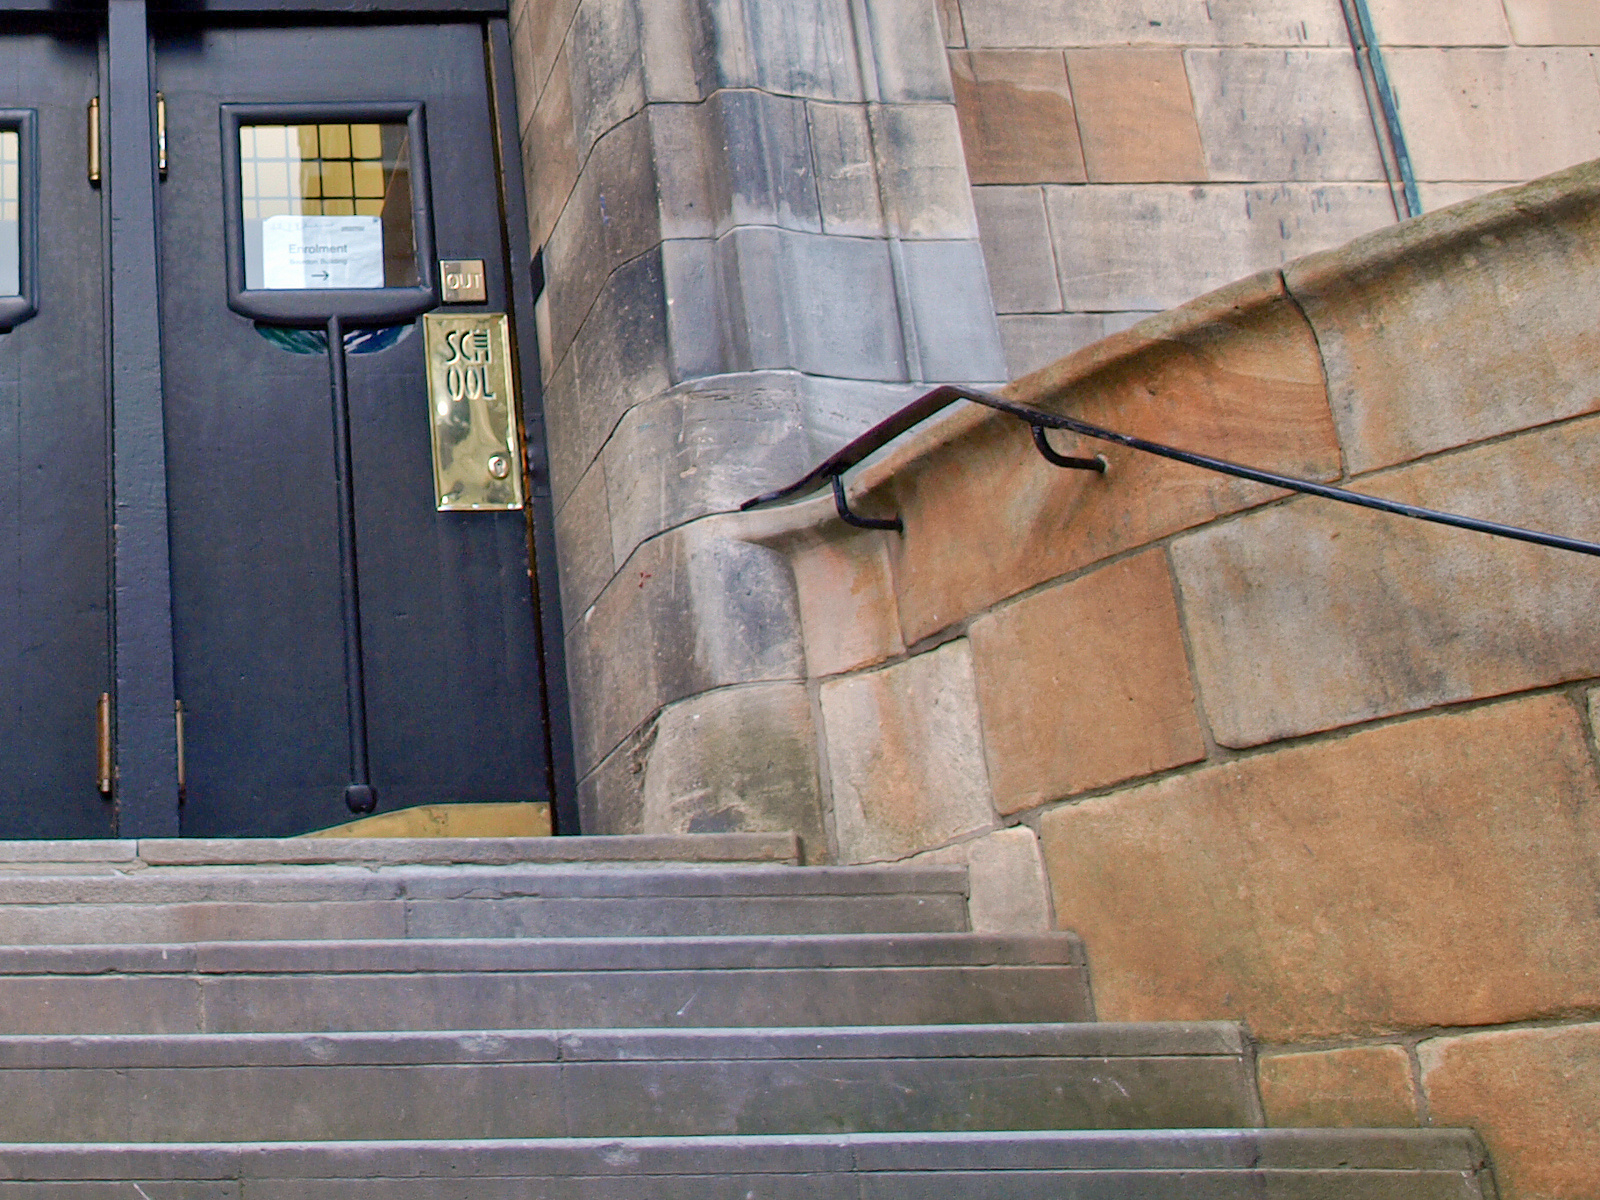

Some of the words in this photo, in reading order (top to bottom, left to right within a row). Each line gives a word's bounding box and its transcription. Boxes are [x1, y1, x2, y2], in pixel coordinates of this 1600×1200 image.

[288, 243, 348, 254] Enrolment
[446, 273, 483, 290] OUT
[446, 328, 492, 365] SCH
[446, 364, 497, 402] OOL
